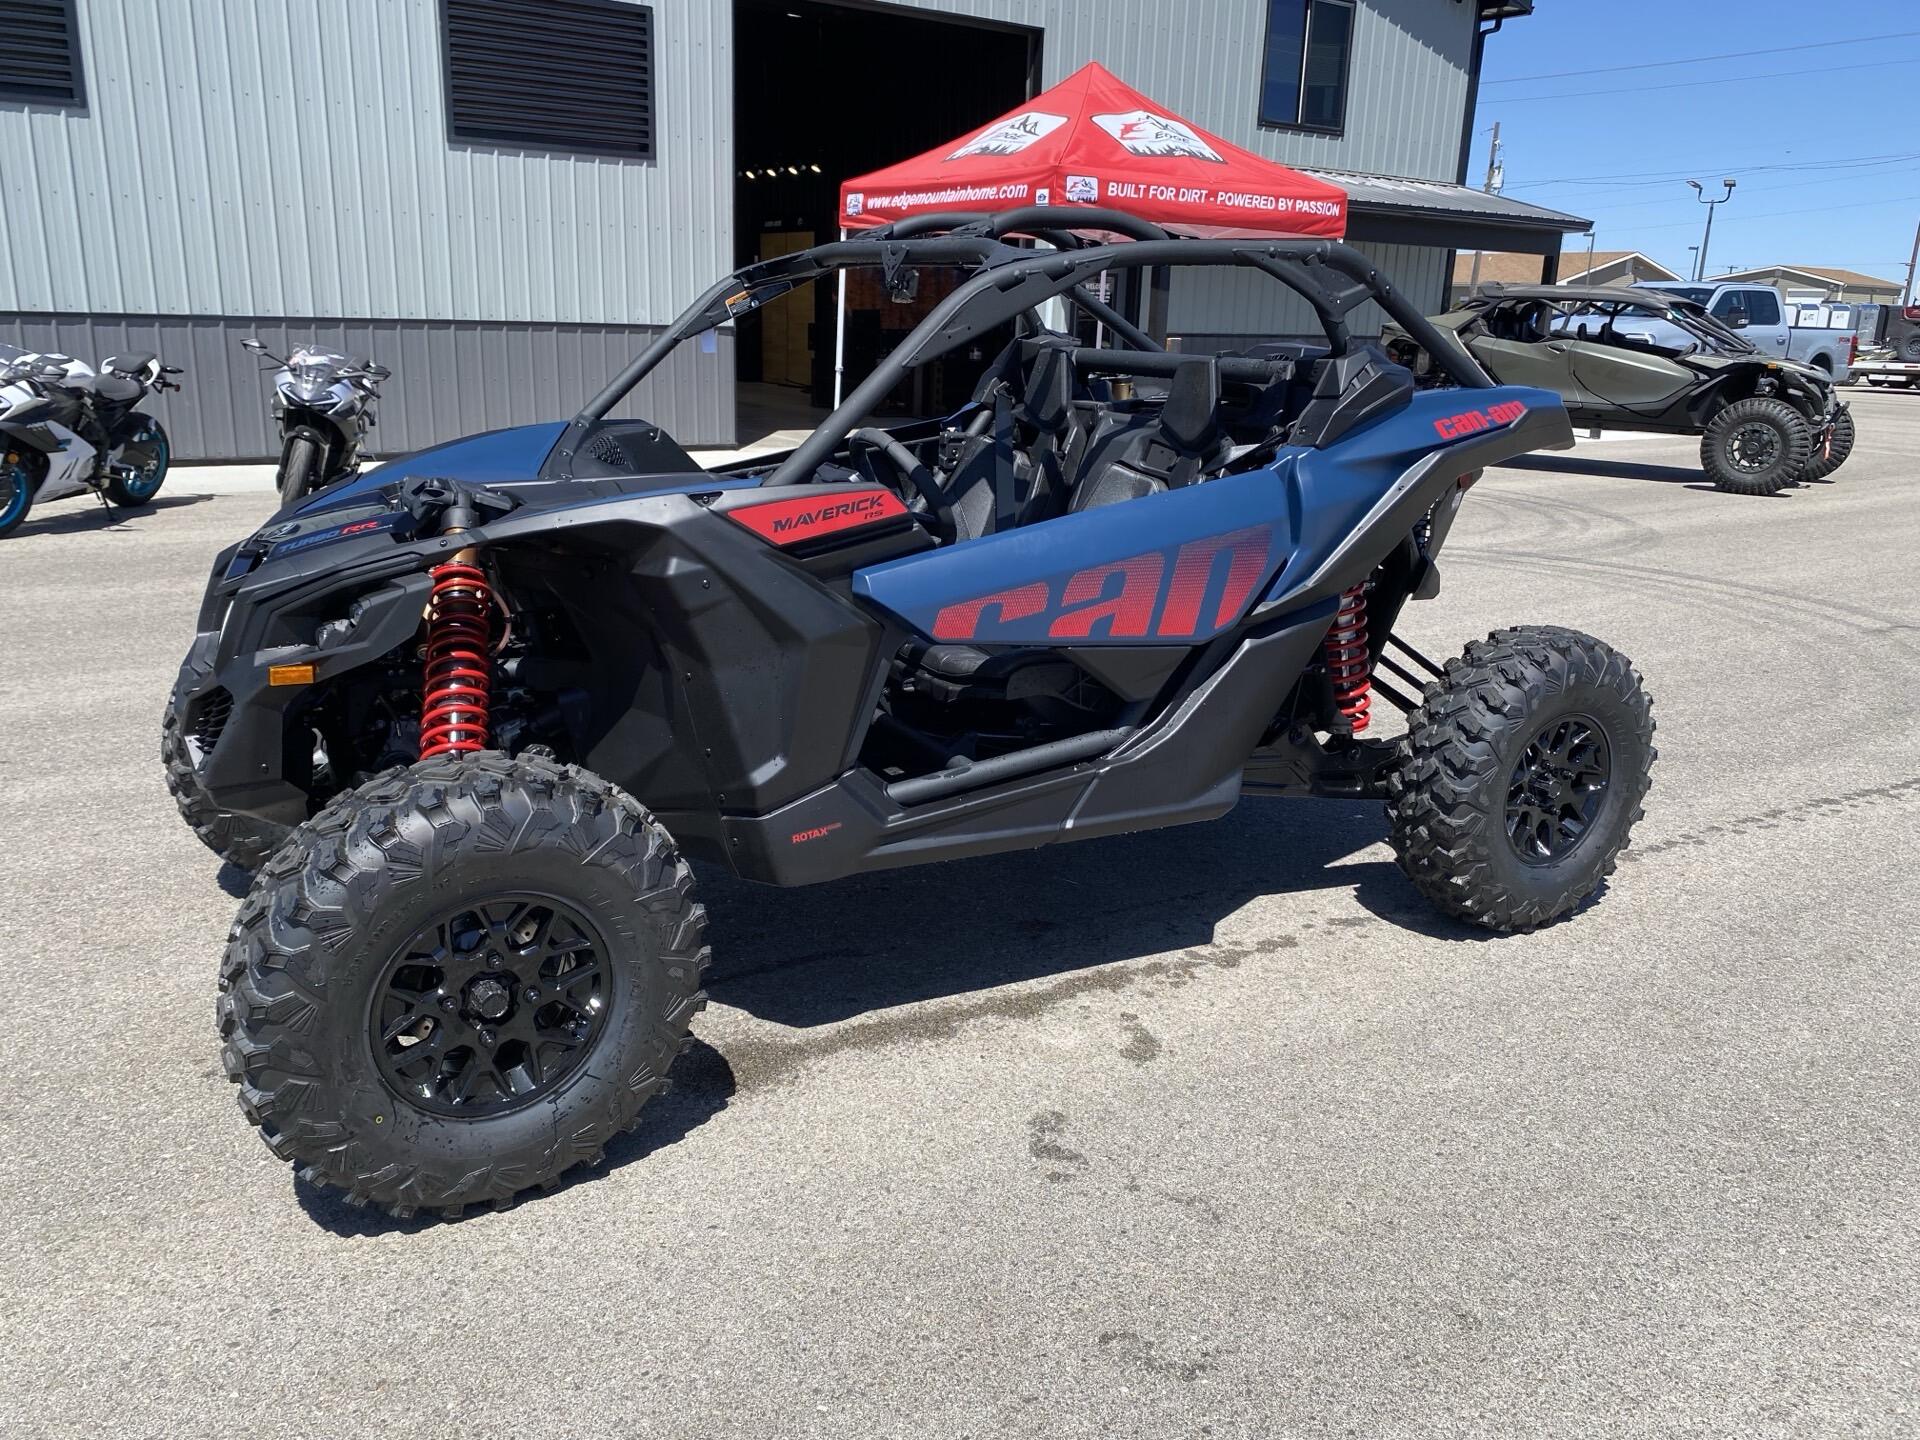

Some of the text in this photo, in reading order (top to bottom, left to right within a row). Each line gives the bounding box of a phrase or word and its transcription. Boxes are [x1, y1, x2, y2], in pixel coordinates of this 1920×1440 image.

[867, 184, 1028, 210] www.edgemountainhome.com
[1107, 182, 1146, 199] BUILT
[1149, 185, 1176, 201] FOR
[1179, 188, 1208, 204] DIRT
[1217, 191, 1276, 210] POWERED
[1278, 198, 1294, 212] BY
[1295, 199, 1340, 217] PASSION
[1433, 400, 1527, 440] can-am
[772, 493, 885, 534] MAVERICK
[864, 509, 884, 520] RS
[279, 520, 379, 553] TURBO RR
[791, 826, 829, 844] ROTAX
